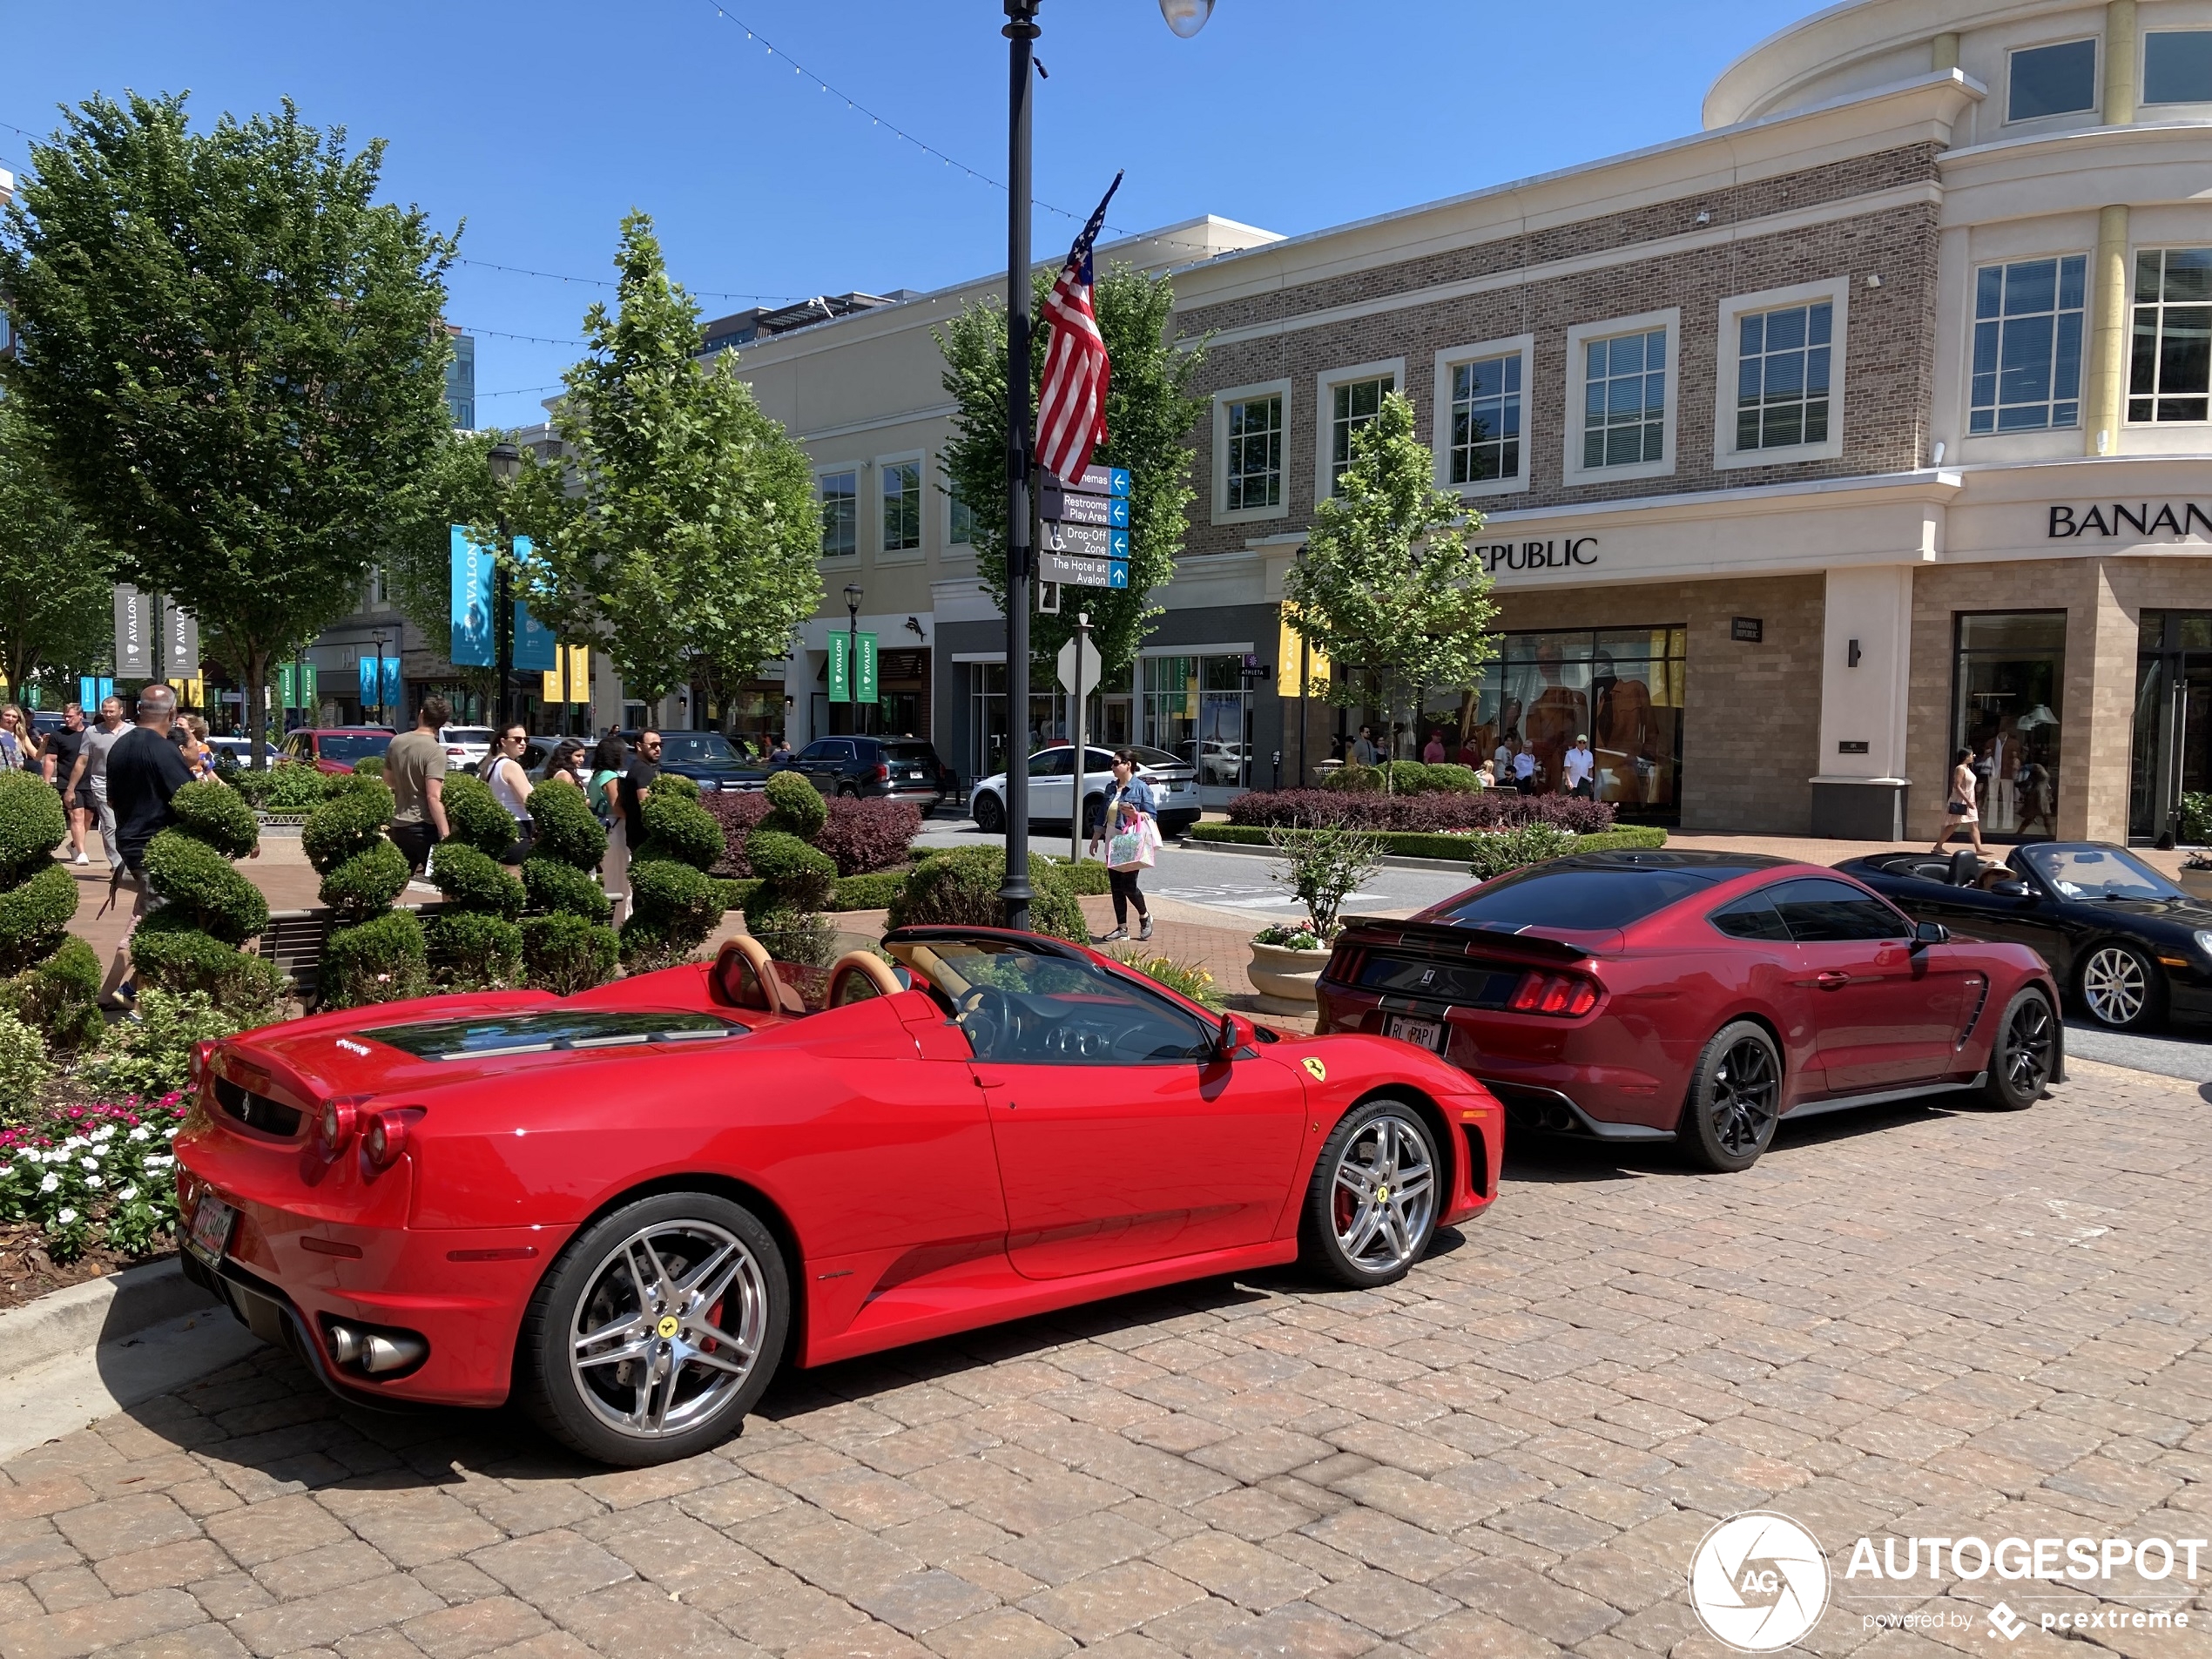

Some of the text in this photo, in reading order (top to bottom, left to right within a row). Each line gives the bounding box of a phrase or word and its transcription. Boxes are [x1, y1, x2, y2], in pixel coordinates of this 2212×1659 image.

[1082, 474, 1108, 485] nemas
[1064, 496, 1108, 510] Restrooms
[1069, 509, 1107, 523] Play Area
[2048, 502, 2212, 537] BANAN
[1067, 528, 1106, 542] Drop-Off
[1084, 543, 1106, 555] Zone
[1052, 557, 1106, 573] The Hotel at
[467, 542, 477, 610] AVALON
[1076, 573, 1106, 585] Avalon
[127, 596, 138, 643] AVALON
[176, 606, 185, 644] AVALO
[1393, 1023, 1433, 1046] RL PAPI
